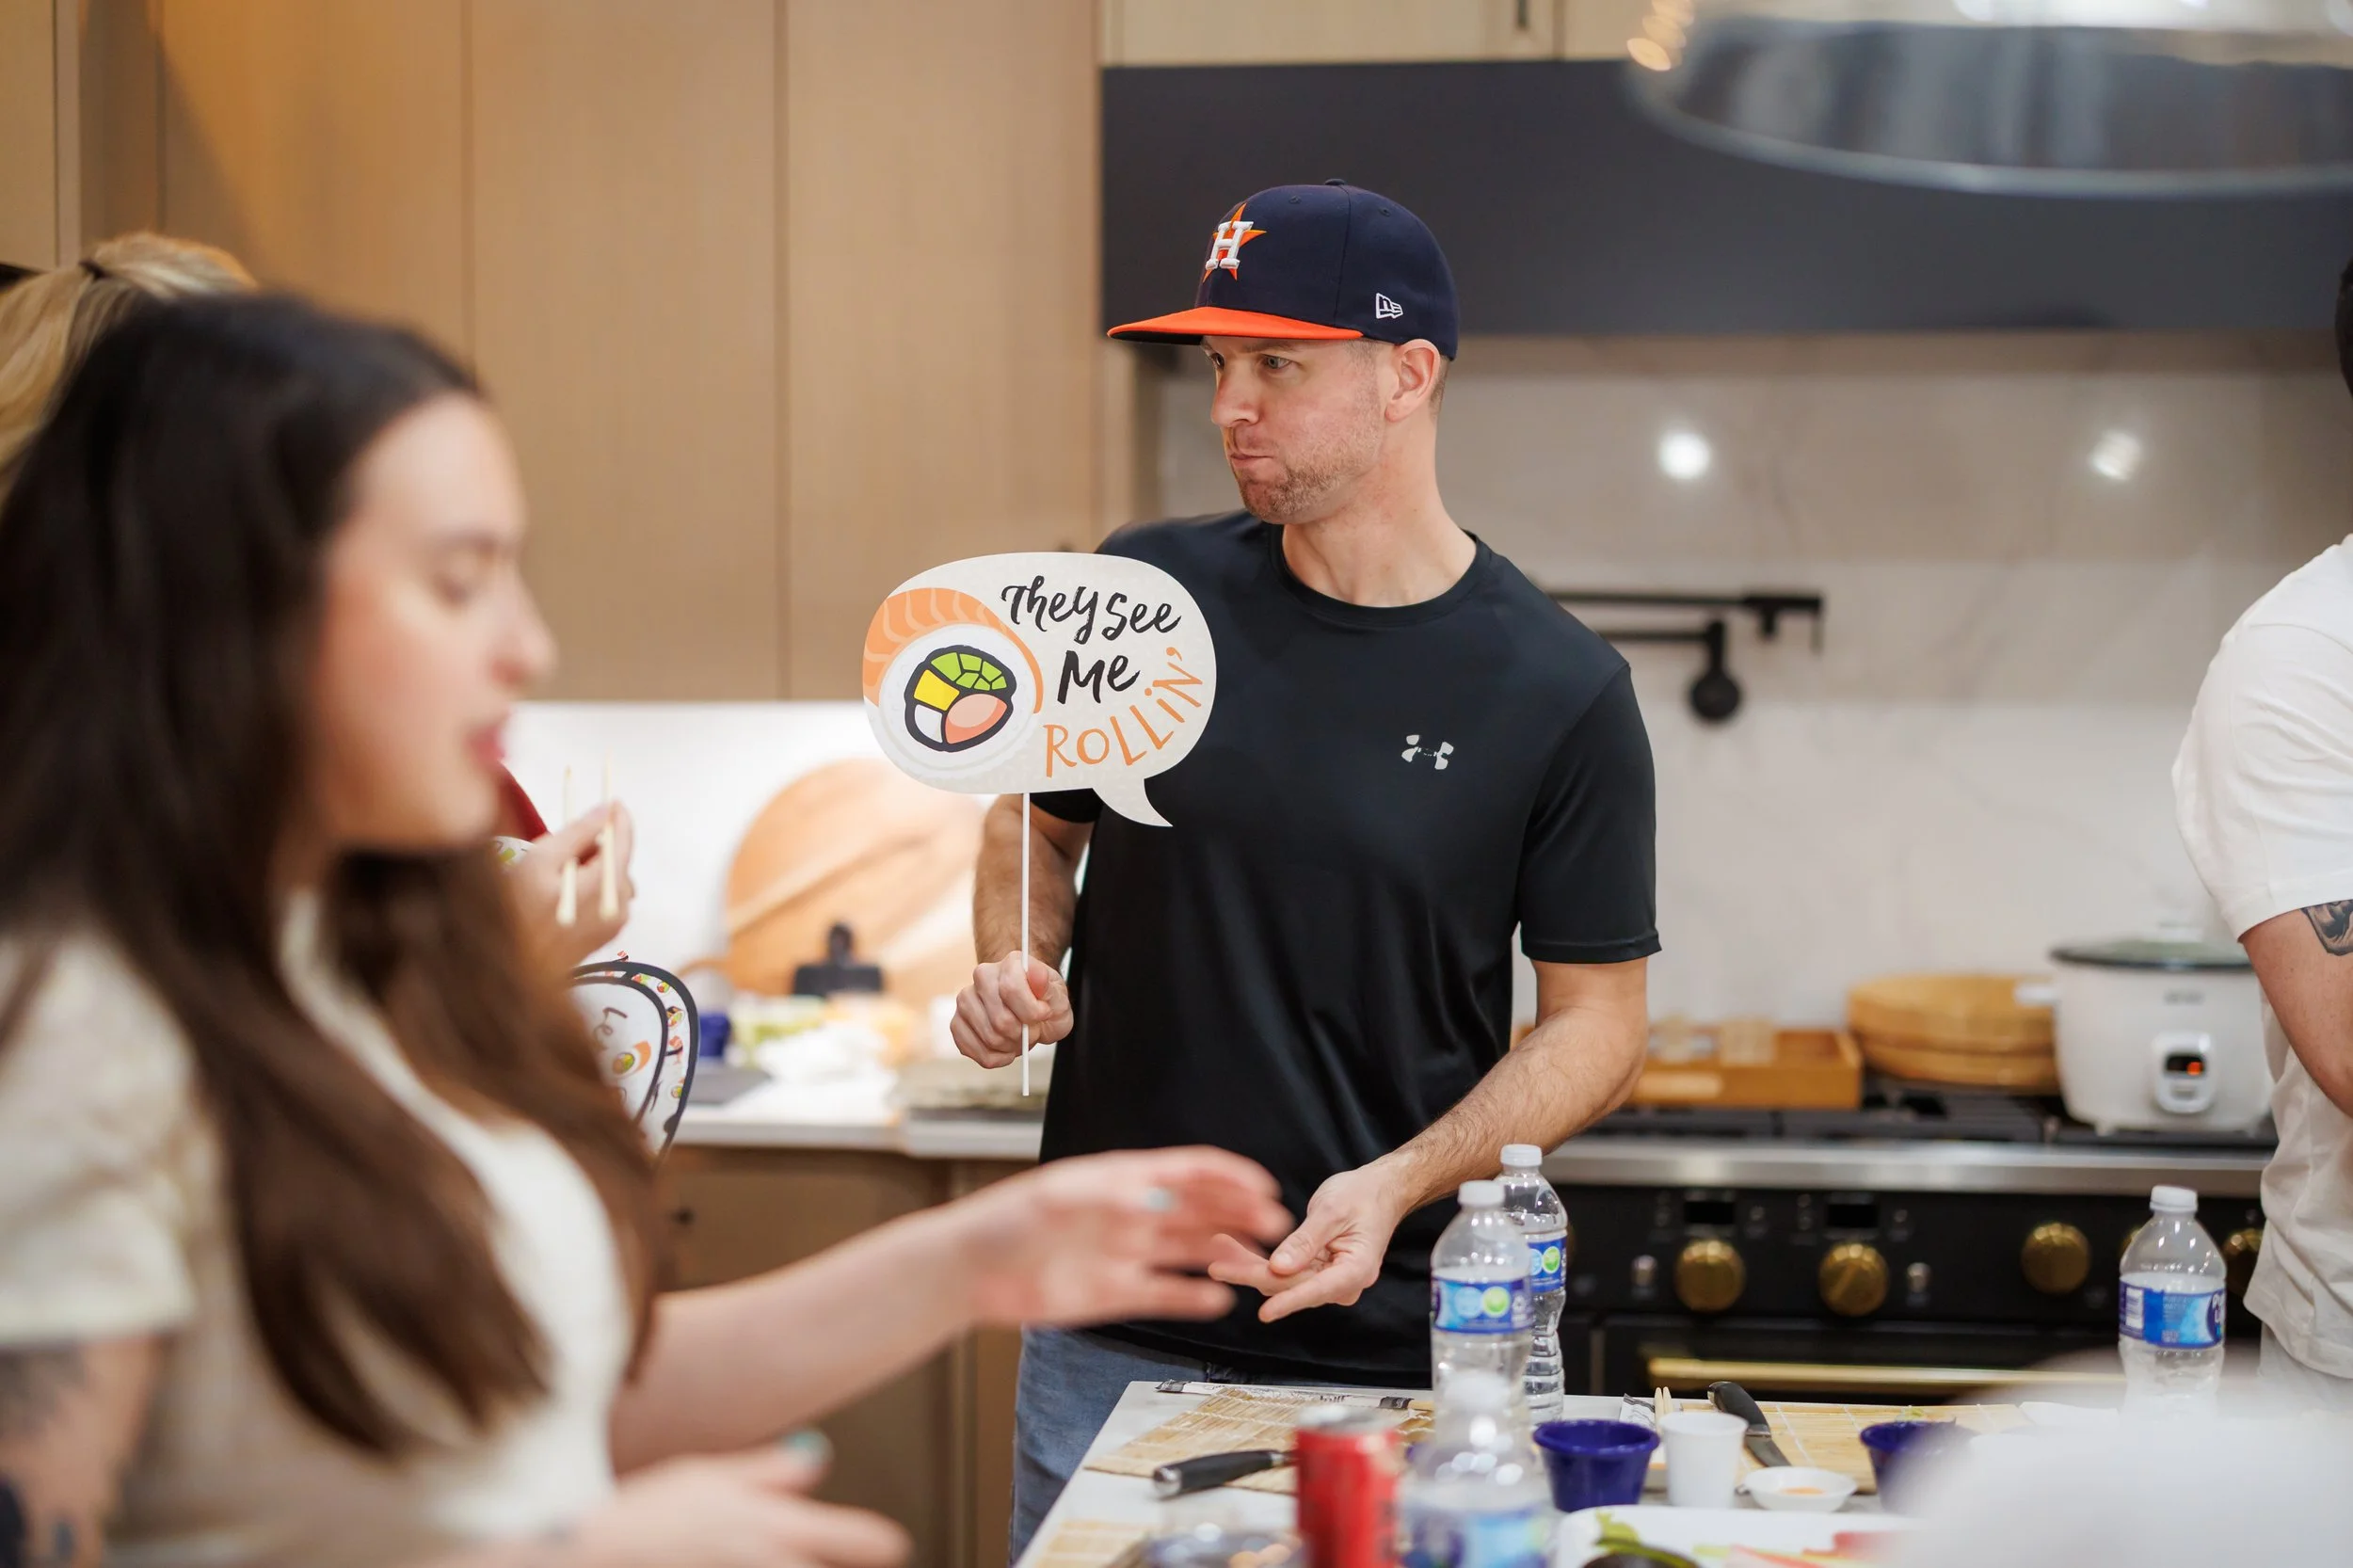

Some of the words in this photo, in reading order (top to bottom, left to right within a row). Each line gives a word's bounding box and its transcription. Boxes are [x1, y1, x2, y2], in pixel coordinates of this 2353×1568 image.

[1205, 220, 1255, 270] H
[1000, 575, 1099, 645] They
[1056, 649, 1141, 706] Me
